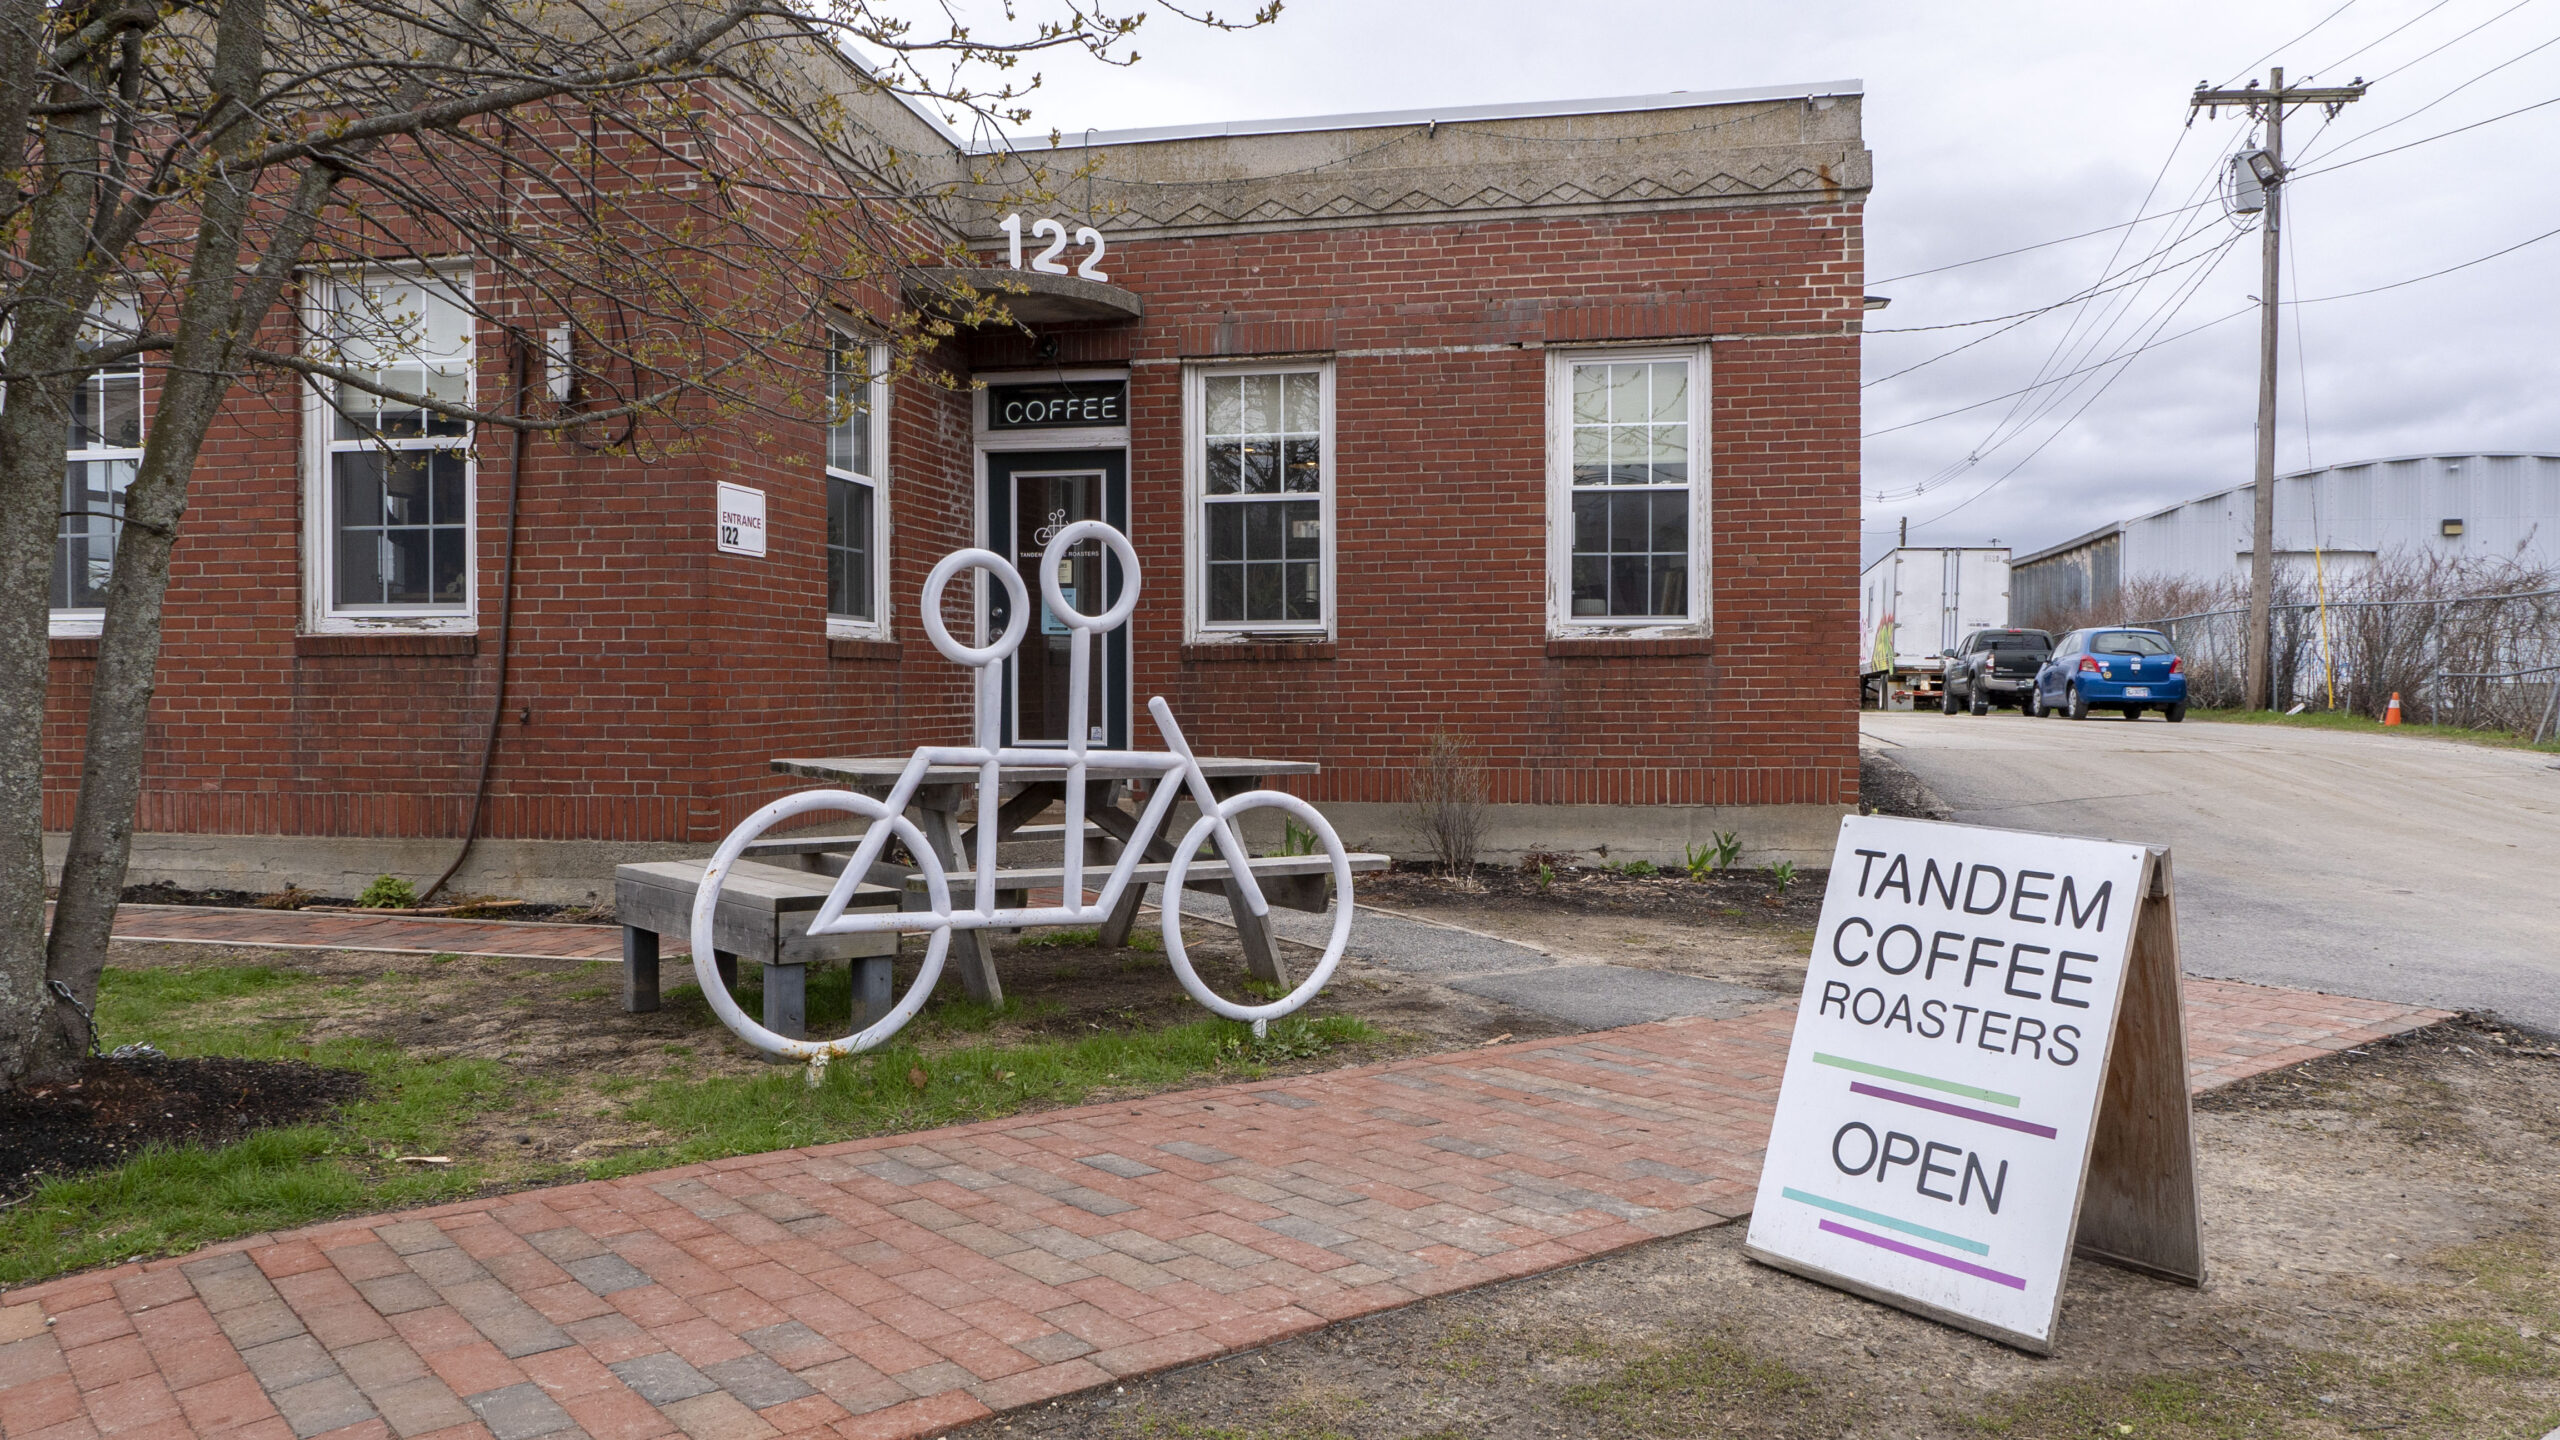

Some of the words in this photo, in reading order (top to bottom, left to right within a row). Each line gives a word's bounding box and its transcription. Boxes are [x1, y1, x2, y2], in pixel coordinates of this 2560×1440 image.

[1000, 212, 1109, 283] 122
[1005, 396, 1118, 423] COFFEE
[721, 525, 739, 546] 122
[722, 511, 762, 529] ENTRANCE
[1854, 848, 2113, 933] TANDEM
[1832, 916, 2099, 1009] COFFEE
[1819, 980, 2081, 1066] ROASTERS
[1832, 1121, 2008, 1215] OPEN
